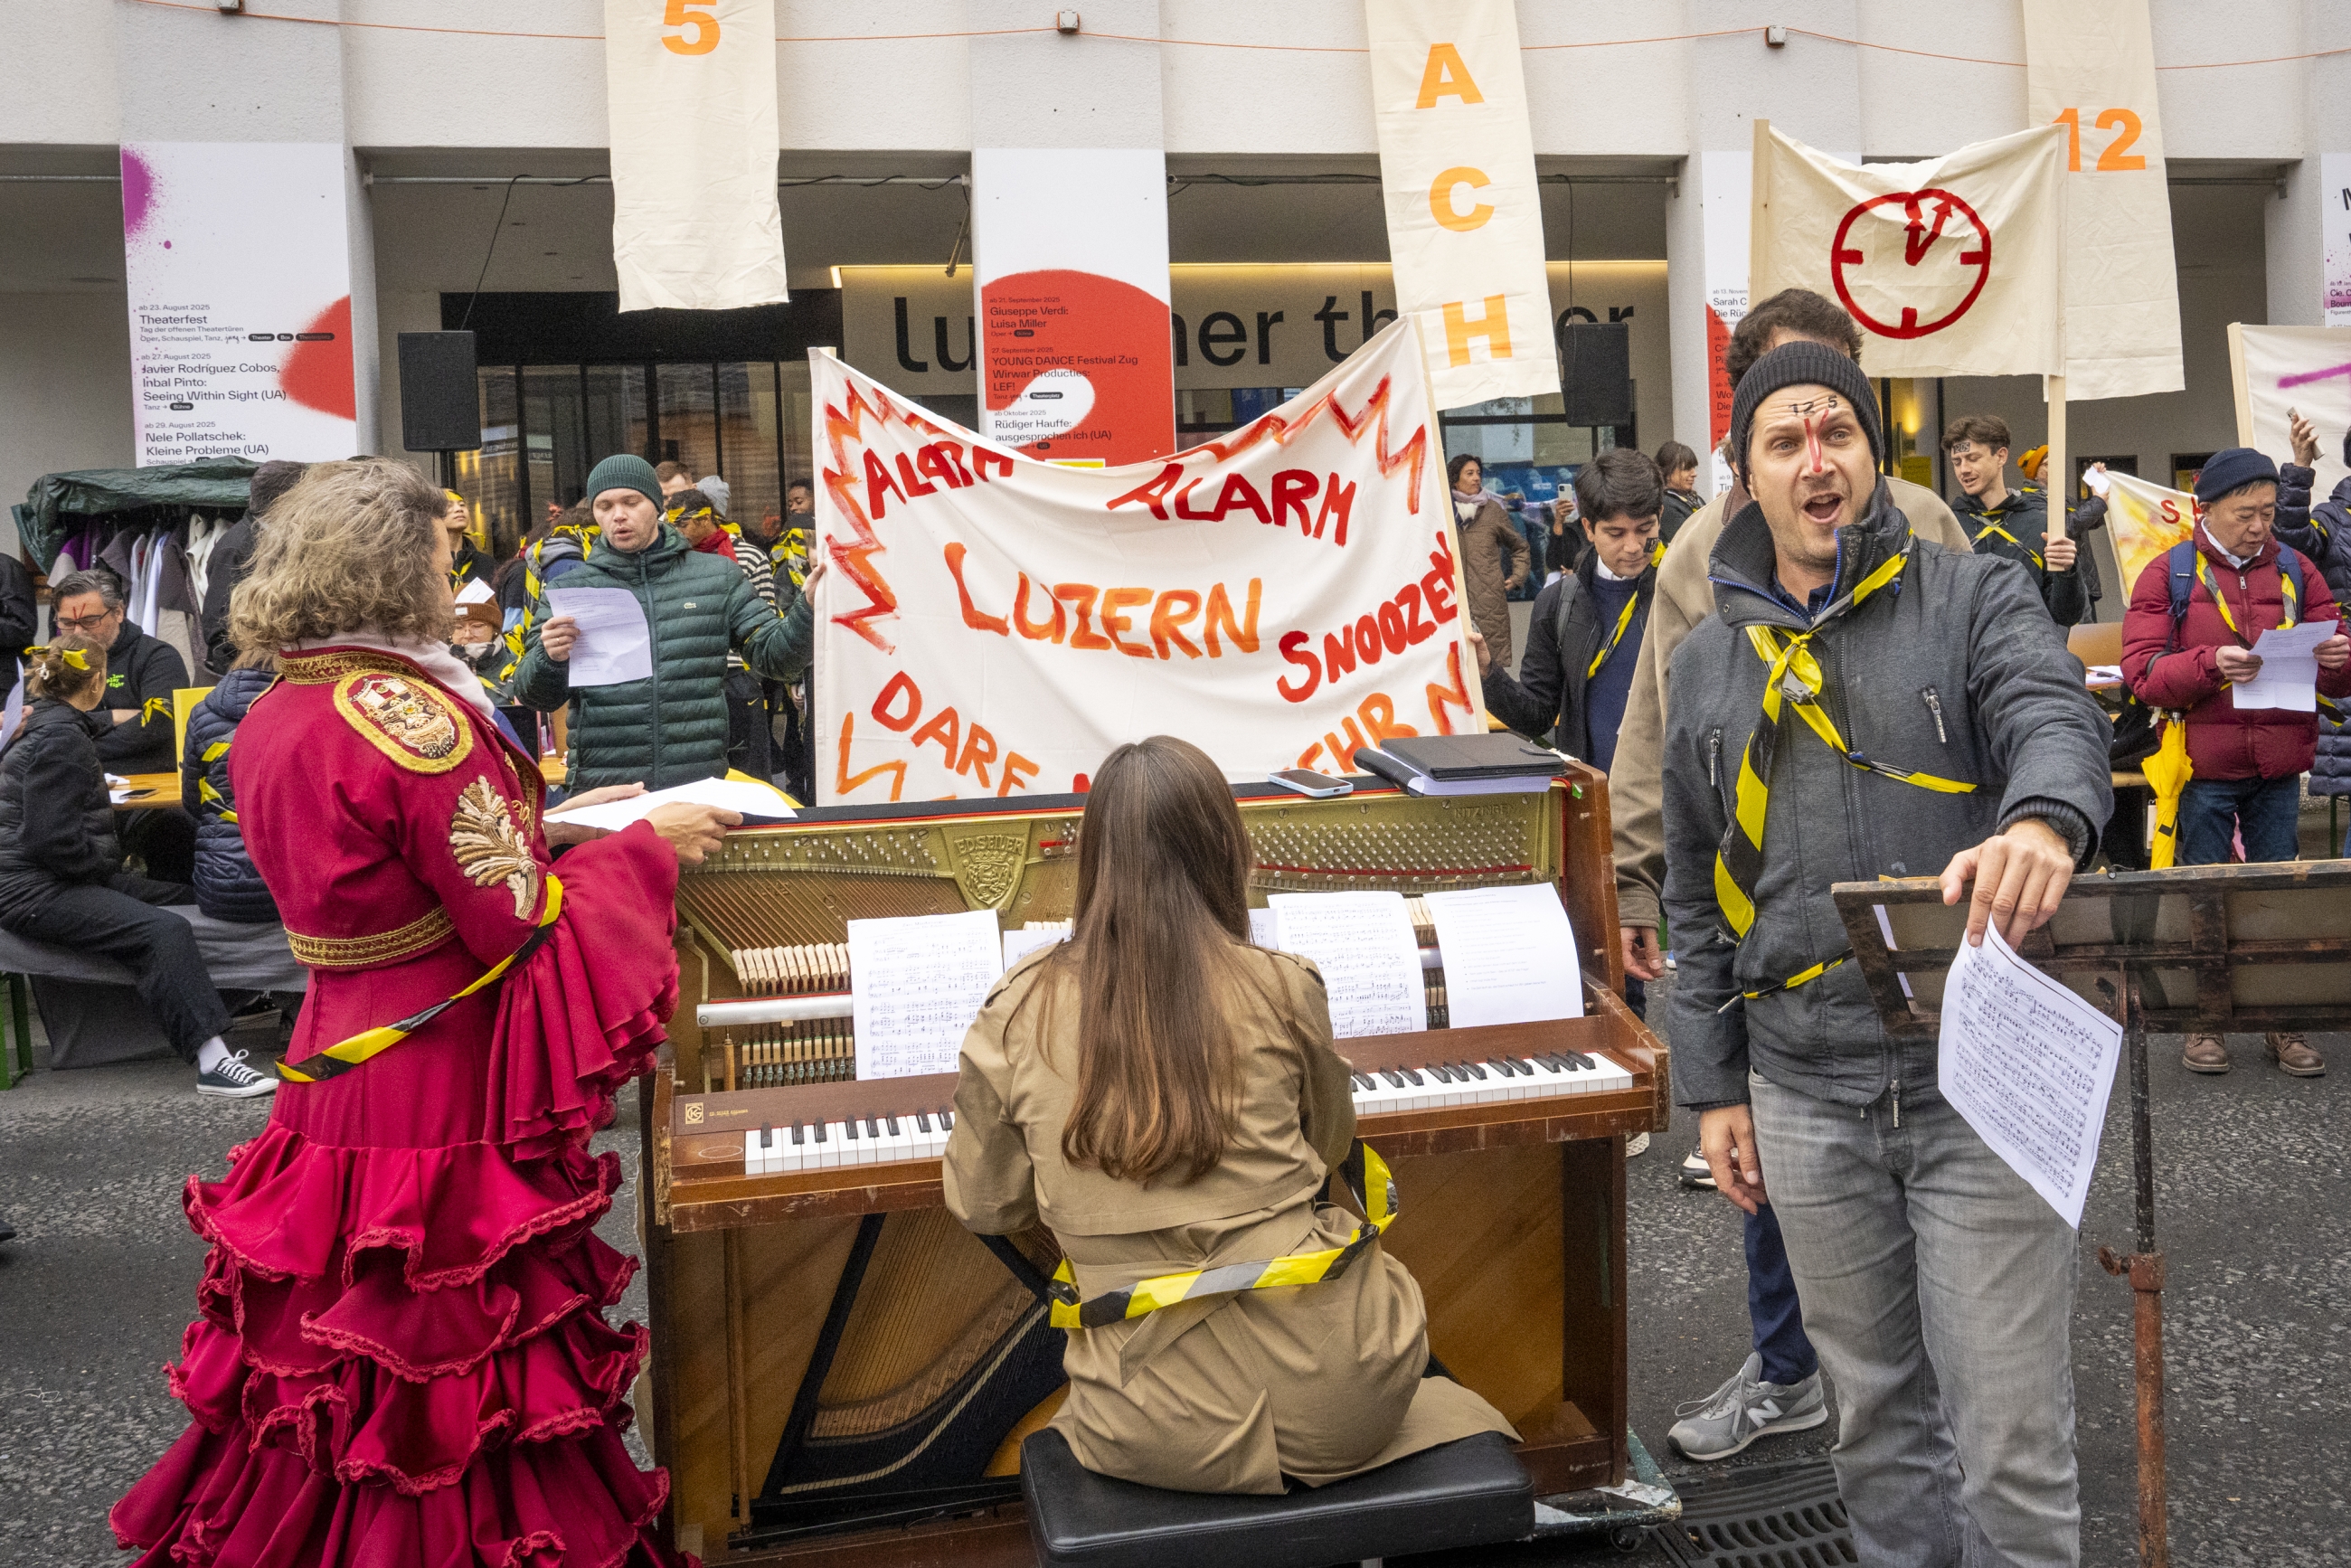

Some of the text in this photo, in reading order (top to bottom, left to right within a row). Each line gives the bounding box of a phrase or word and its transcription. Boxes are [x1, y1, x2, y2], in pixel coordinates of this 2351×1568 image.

[661, 0, 721, 55] 5
[2052, 108, 2146, 171] 12
[1714, 298, 1738, 306] Sarah
[990, 306, 1069, 317] Giuseppe Verdi:
[1714, 309, 1728, 317] Die
[139, 315, 208, 325] Theaterfest
[991, 318, 1047, 328] Luisa Miller
[164, 354, 190, 362] August
[993, 355, 1138, 366] YOUNG DANCE Festival Zug
[142, 363, 280, 375] Javier Rodríguez Cobos,
[993, 368, 1091, 379] Wirwar Producties:
[143, 378, 207, 387] Inbal Pinto:
[994, 383, 1015, 392] LEF!
[143, 390, 287, 403] Seeing Within Sight (UA)
[995, 419, 1072, 430] Rüdiger Hauffe:
[146, 431, 246, 442] Nele Pollatschek:
[996, 430, 1111, 443] ausgesprochen ich (UA)
[146, 444, 269, 456] Kleine Probleme (UA)
[864, 441, 1356, 548] ALARM ALARM
[944, 542, 1261, 660] LUZERN
[1277, 531, 1458, 703] SNOOZEN
[872, 671, 1040, 797] DARF
